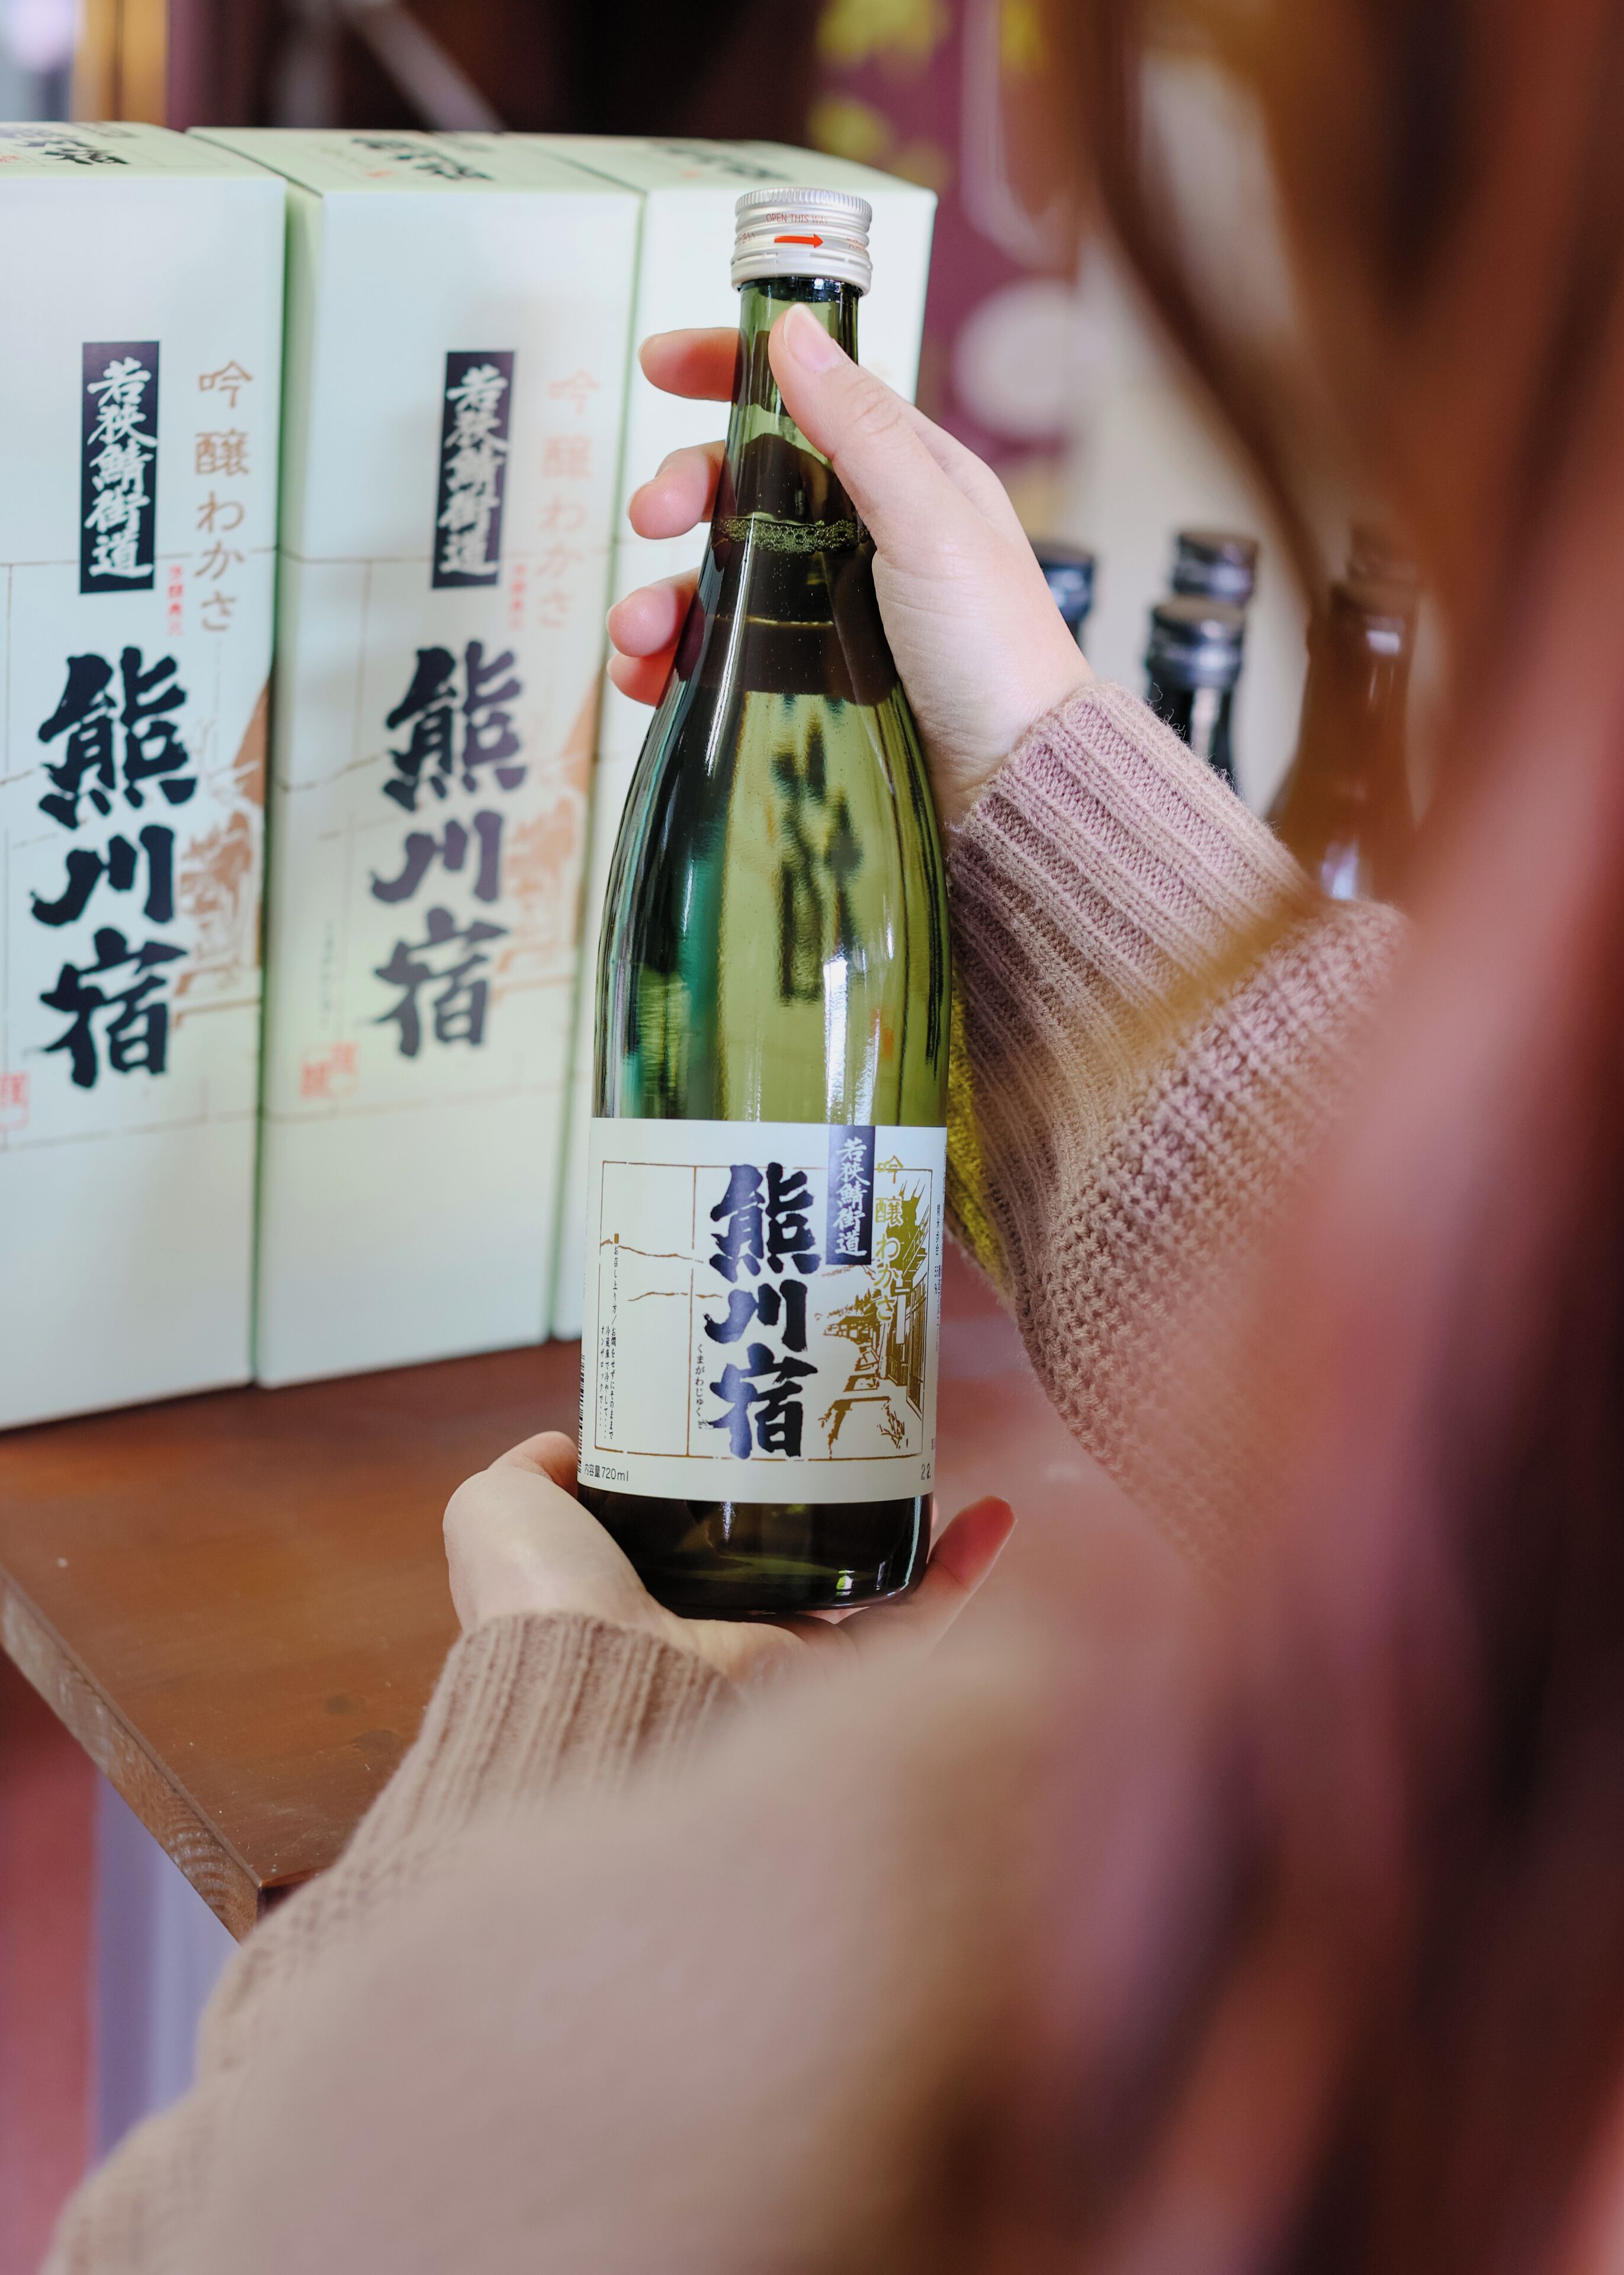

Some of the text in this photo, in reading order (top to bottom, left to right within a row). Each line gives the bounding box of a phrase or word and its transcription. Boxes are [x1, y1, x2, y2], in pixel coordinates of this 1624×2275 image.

[766, 213, 829, 225] OPEN THIS WAY
[86, 356, 158, 579] 若狭鯖街道
[194, 360, 252, 632] 吟醸わかさ
[28, 646, 198, 1089] 熊川宿
[369, 640, 527, 1059] 熊川宿
[833, 1137, 871, 1257] 若狭鯖街道
[874, 1155, 904, 1321] 吟醸わかさ
[695, 1344, 705, 1417] くまがわじゅく
[704, 1162, 821, 1460] 熊川宿
[584, 1463, 628, 1482] 内容量720ml
